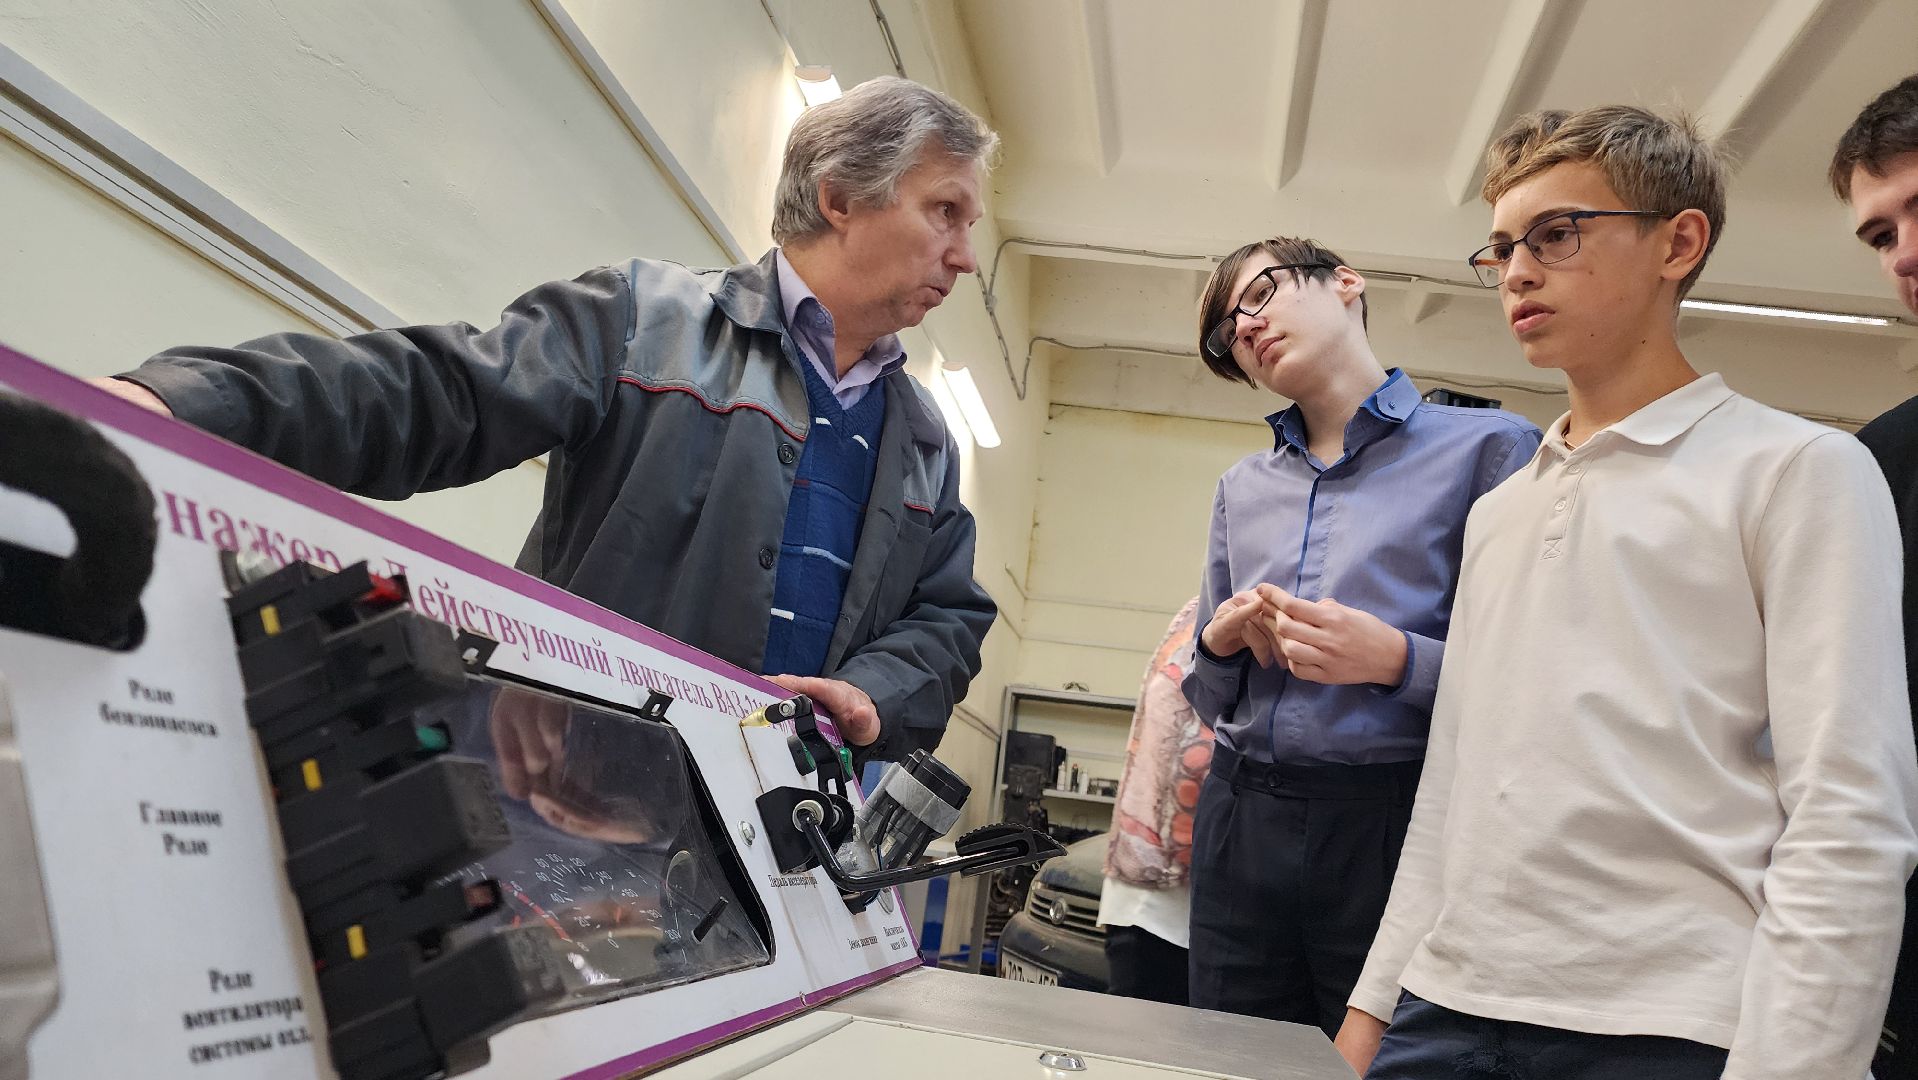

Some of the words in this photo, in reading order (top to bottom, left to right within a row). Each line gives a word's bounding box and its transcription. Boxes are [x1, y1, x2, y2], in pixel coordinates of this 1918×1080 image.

[615, 655, 713, 710] двигатель
[138, 800, 223, 828] Главное
[162, 832, 210, 856] Реле
[183, 996, 304, 1031] вентилятора
